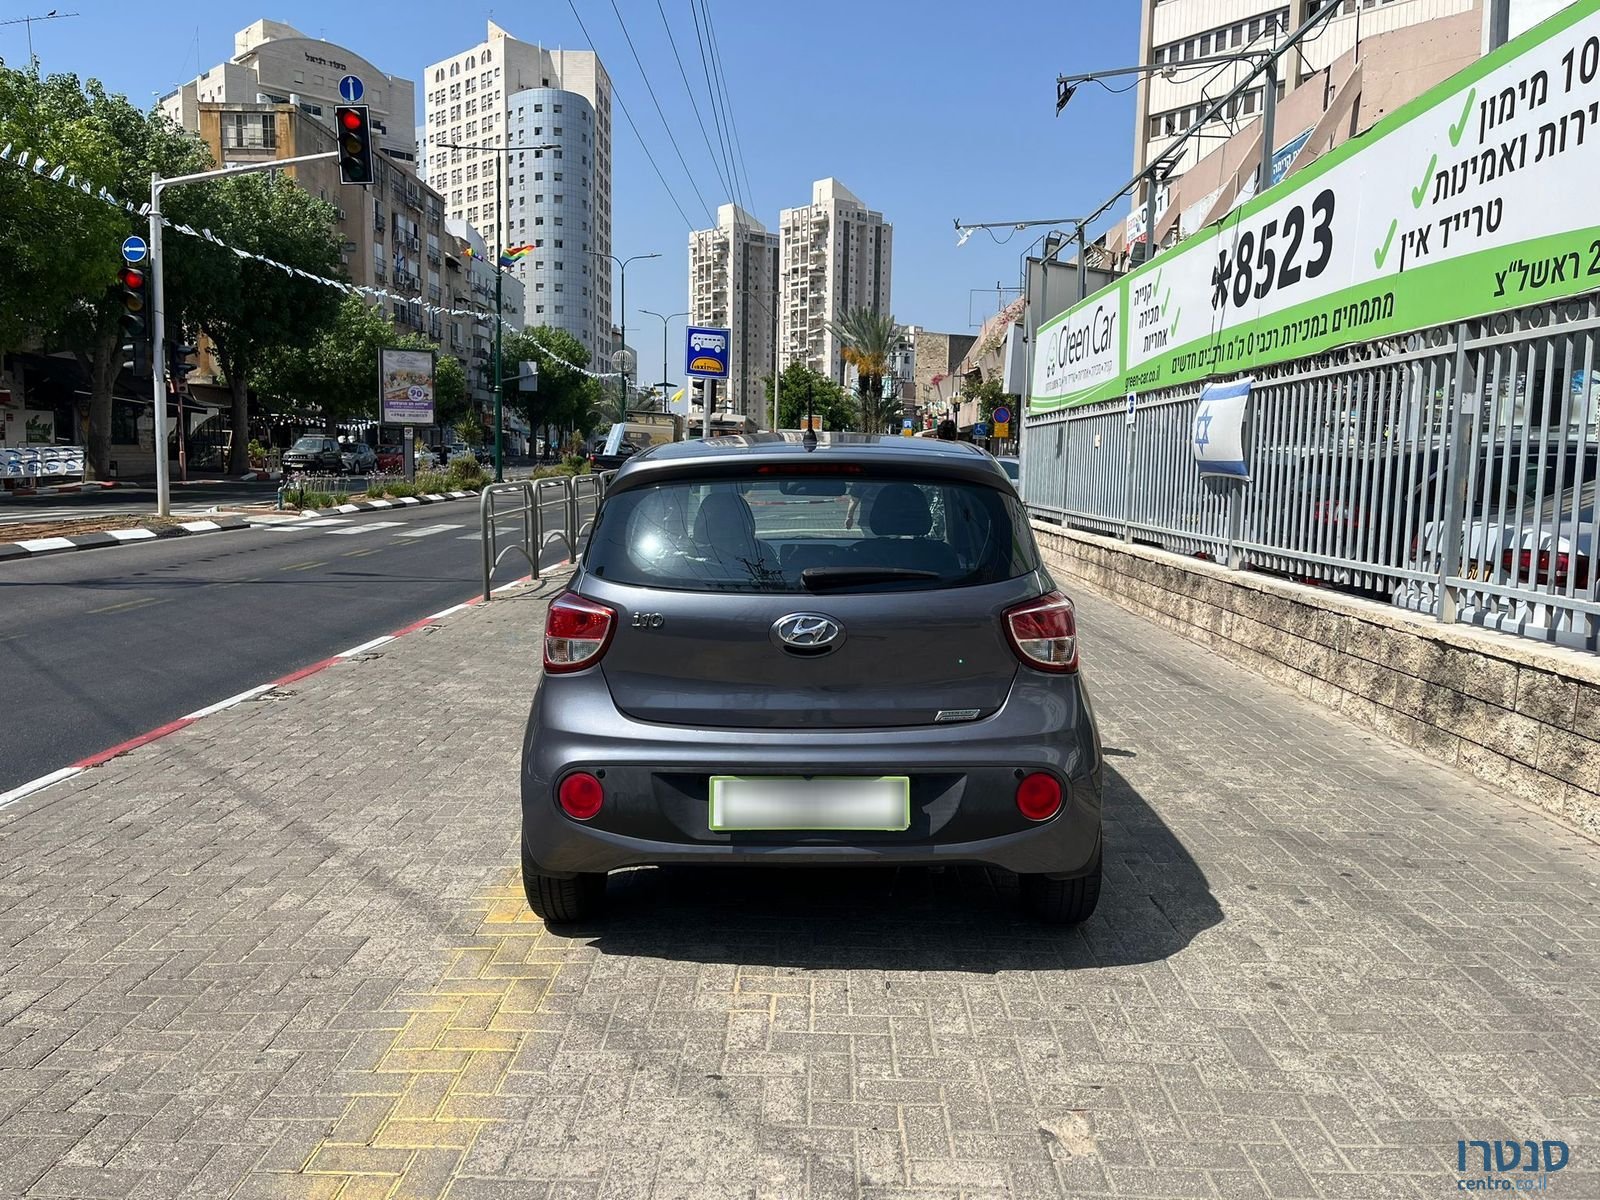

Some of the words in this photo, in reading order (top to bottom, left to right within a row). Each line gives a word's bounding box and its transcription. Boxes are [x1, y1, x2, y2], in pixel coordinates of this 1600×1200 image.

[1479, 70, 1548, 144] מימון
[1433, 133, 1528, 204] ואמינות
[1439, 198, 1503, 248] טרייד
[1400, 224, 1432, 272] אין
[1134, 282, 1153, 306] קנייה
[1138, 304, 1160, 329] מכירה
[1332, 292, 1394, 332] מתמחים
[1058, 324, 1090, 369] Green
[1092, 305, 1117, 355] Car
[1143, 327, 1169, 353] אחריות
[1256, 328, 1279, 353] רכבי
[1281, 313, 1328, 346] במכירת
[1171, 352, 1197, 375] חדשים
[1124, 364, 1161, 392] green-car.co.il
[410, 389, 423, 398] 90
[631, 611, 664, 627] i10
